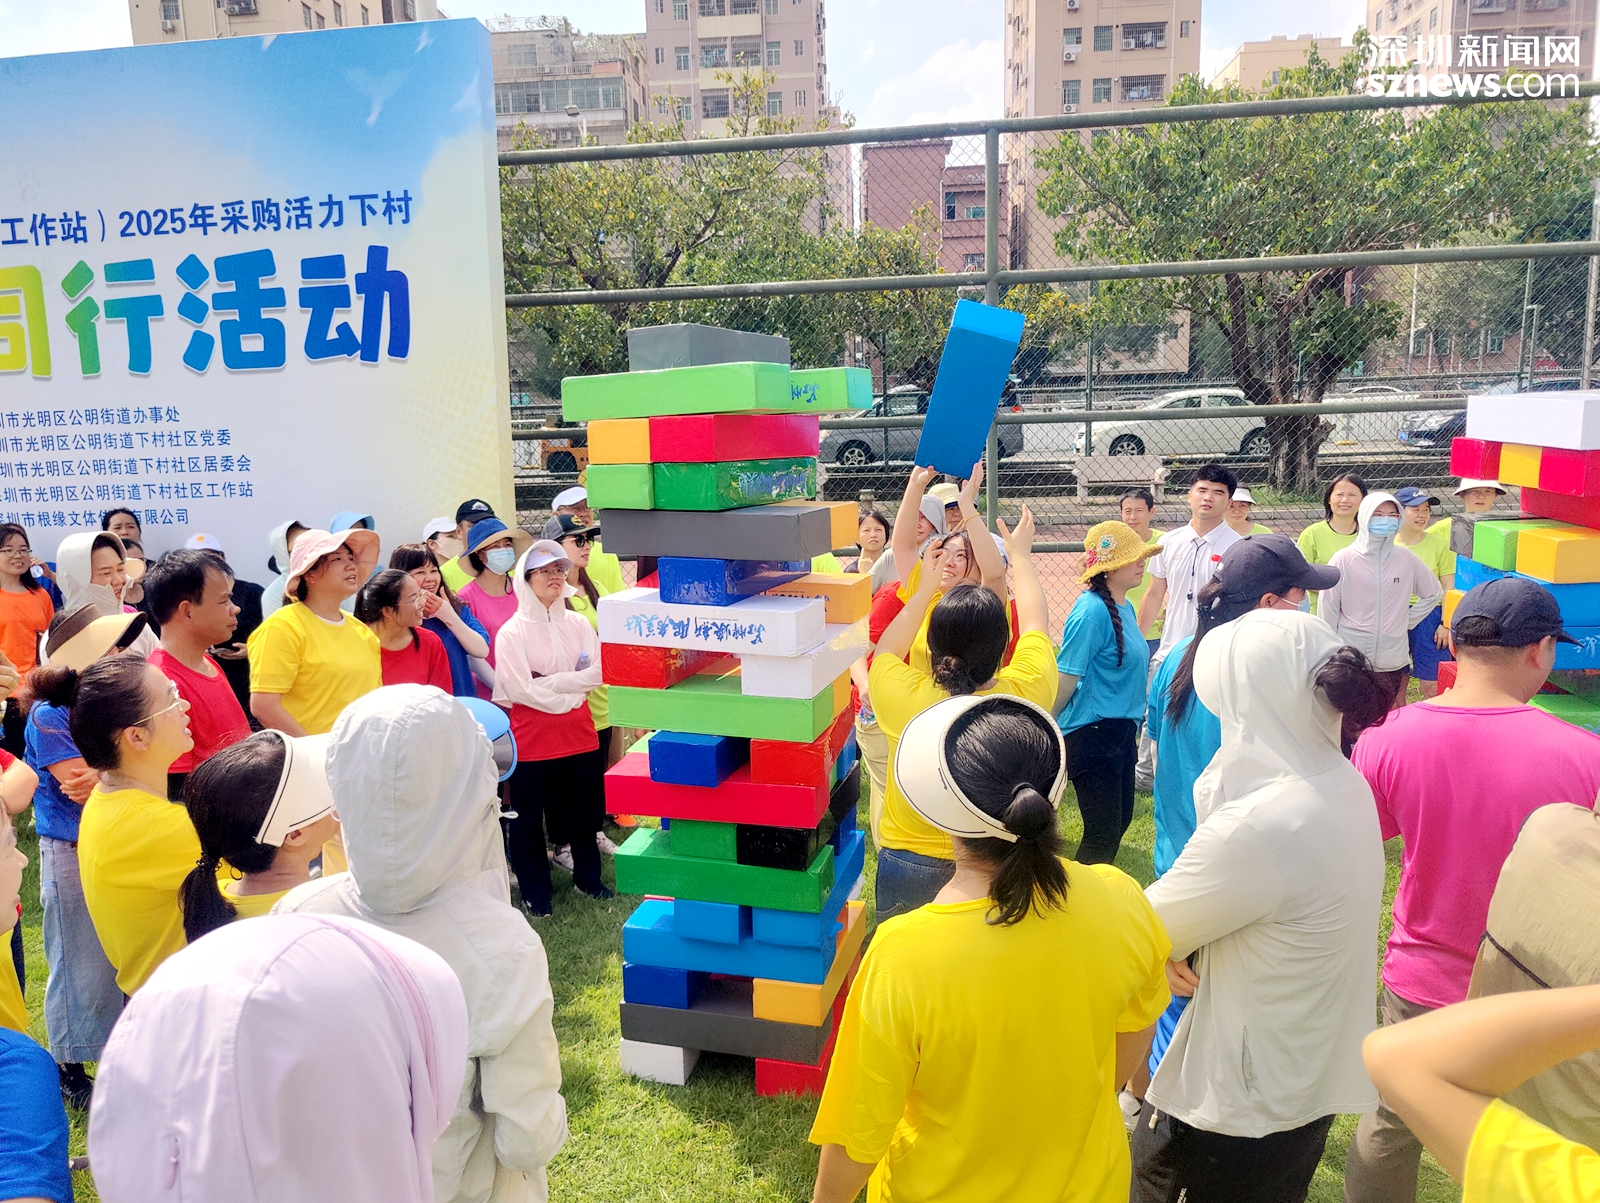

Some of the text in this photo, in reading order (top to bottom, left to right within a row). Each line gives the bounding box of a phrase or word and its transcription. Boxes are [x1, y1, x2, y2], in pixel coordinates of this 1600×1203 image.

[0, 481, 254, 503] 圳市光明区公明街道下村社区工作站
